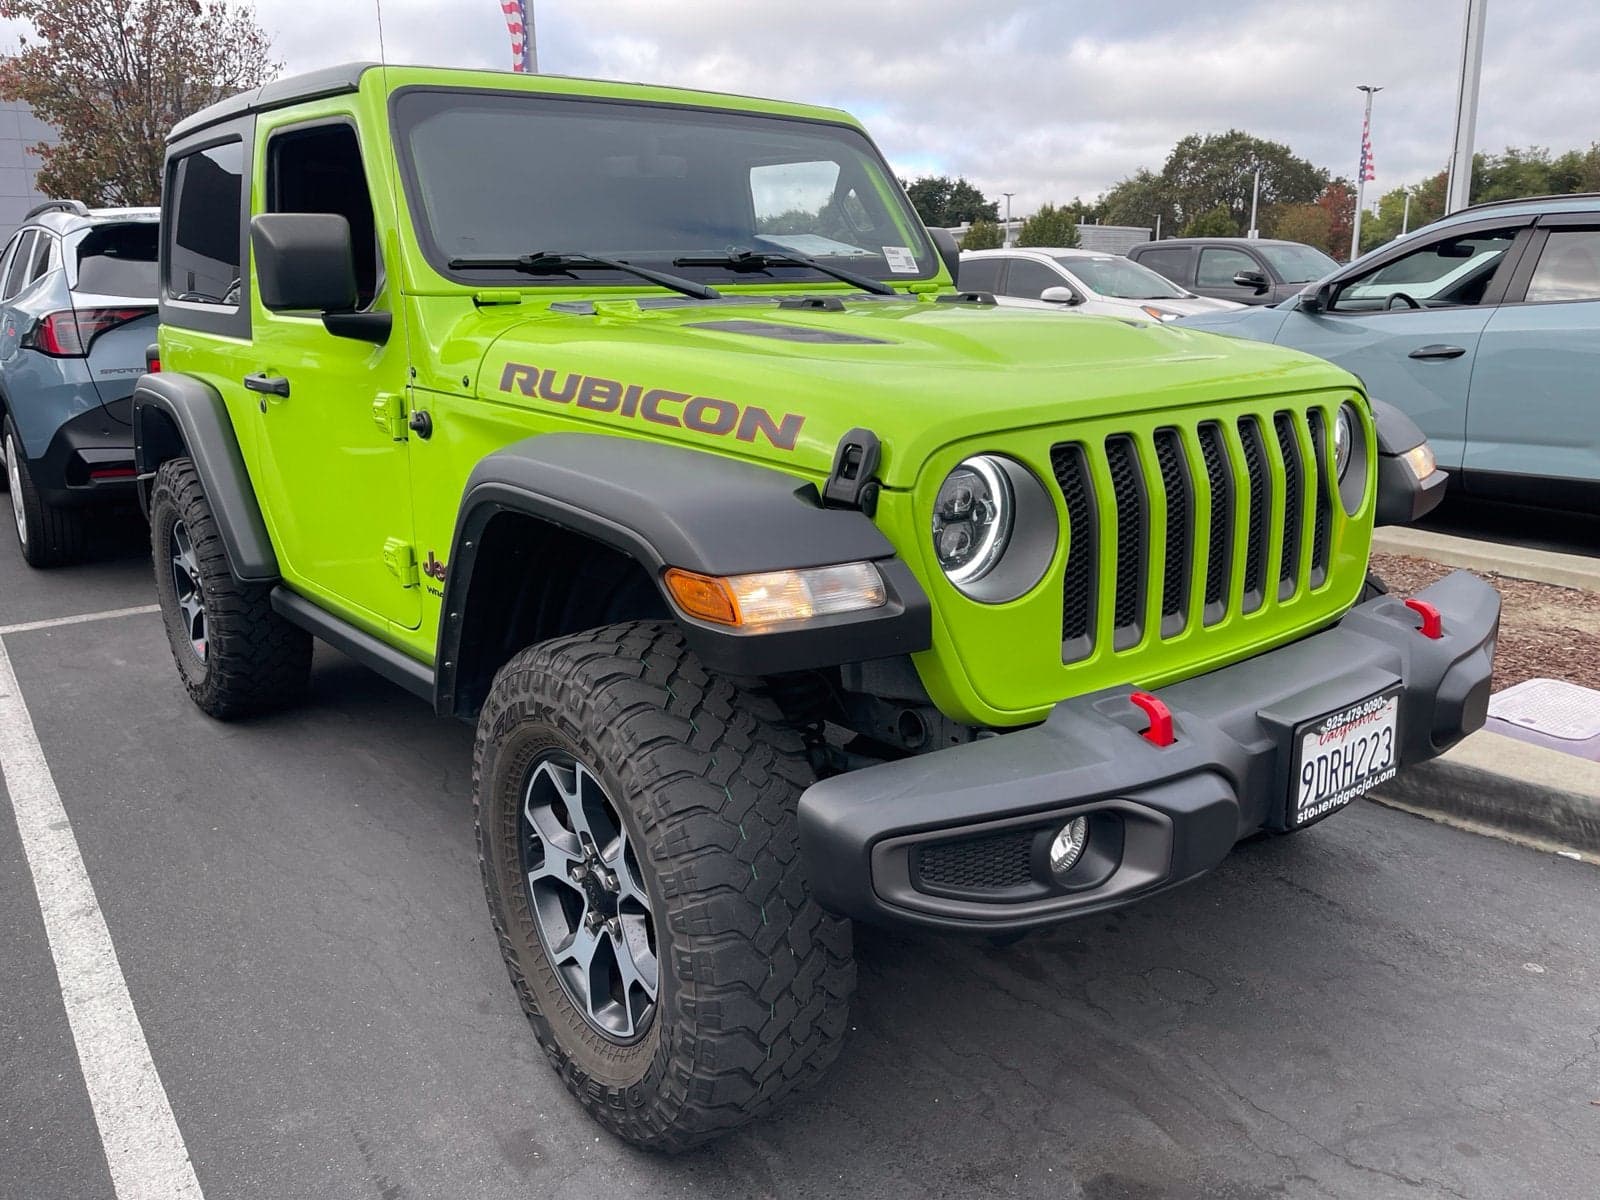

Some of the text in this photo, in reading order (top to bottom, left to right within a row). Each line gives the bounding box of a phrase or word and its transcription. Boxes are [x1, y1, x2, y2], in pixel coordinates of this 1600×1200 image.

[499, 362, 806, 451] RUBICON
[1297, 767, 1396, 824] stoneridgecjd.com
[1299, 725, 1392, 808] 9DRH223
